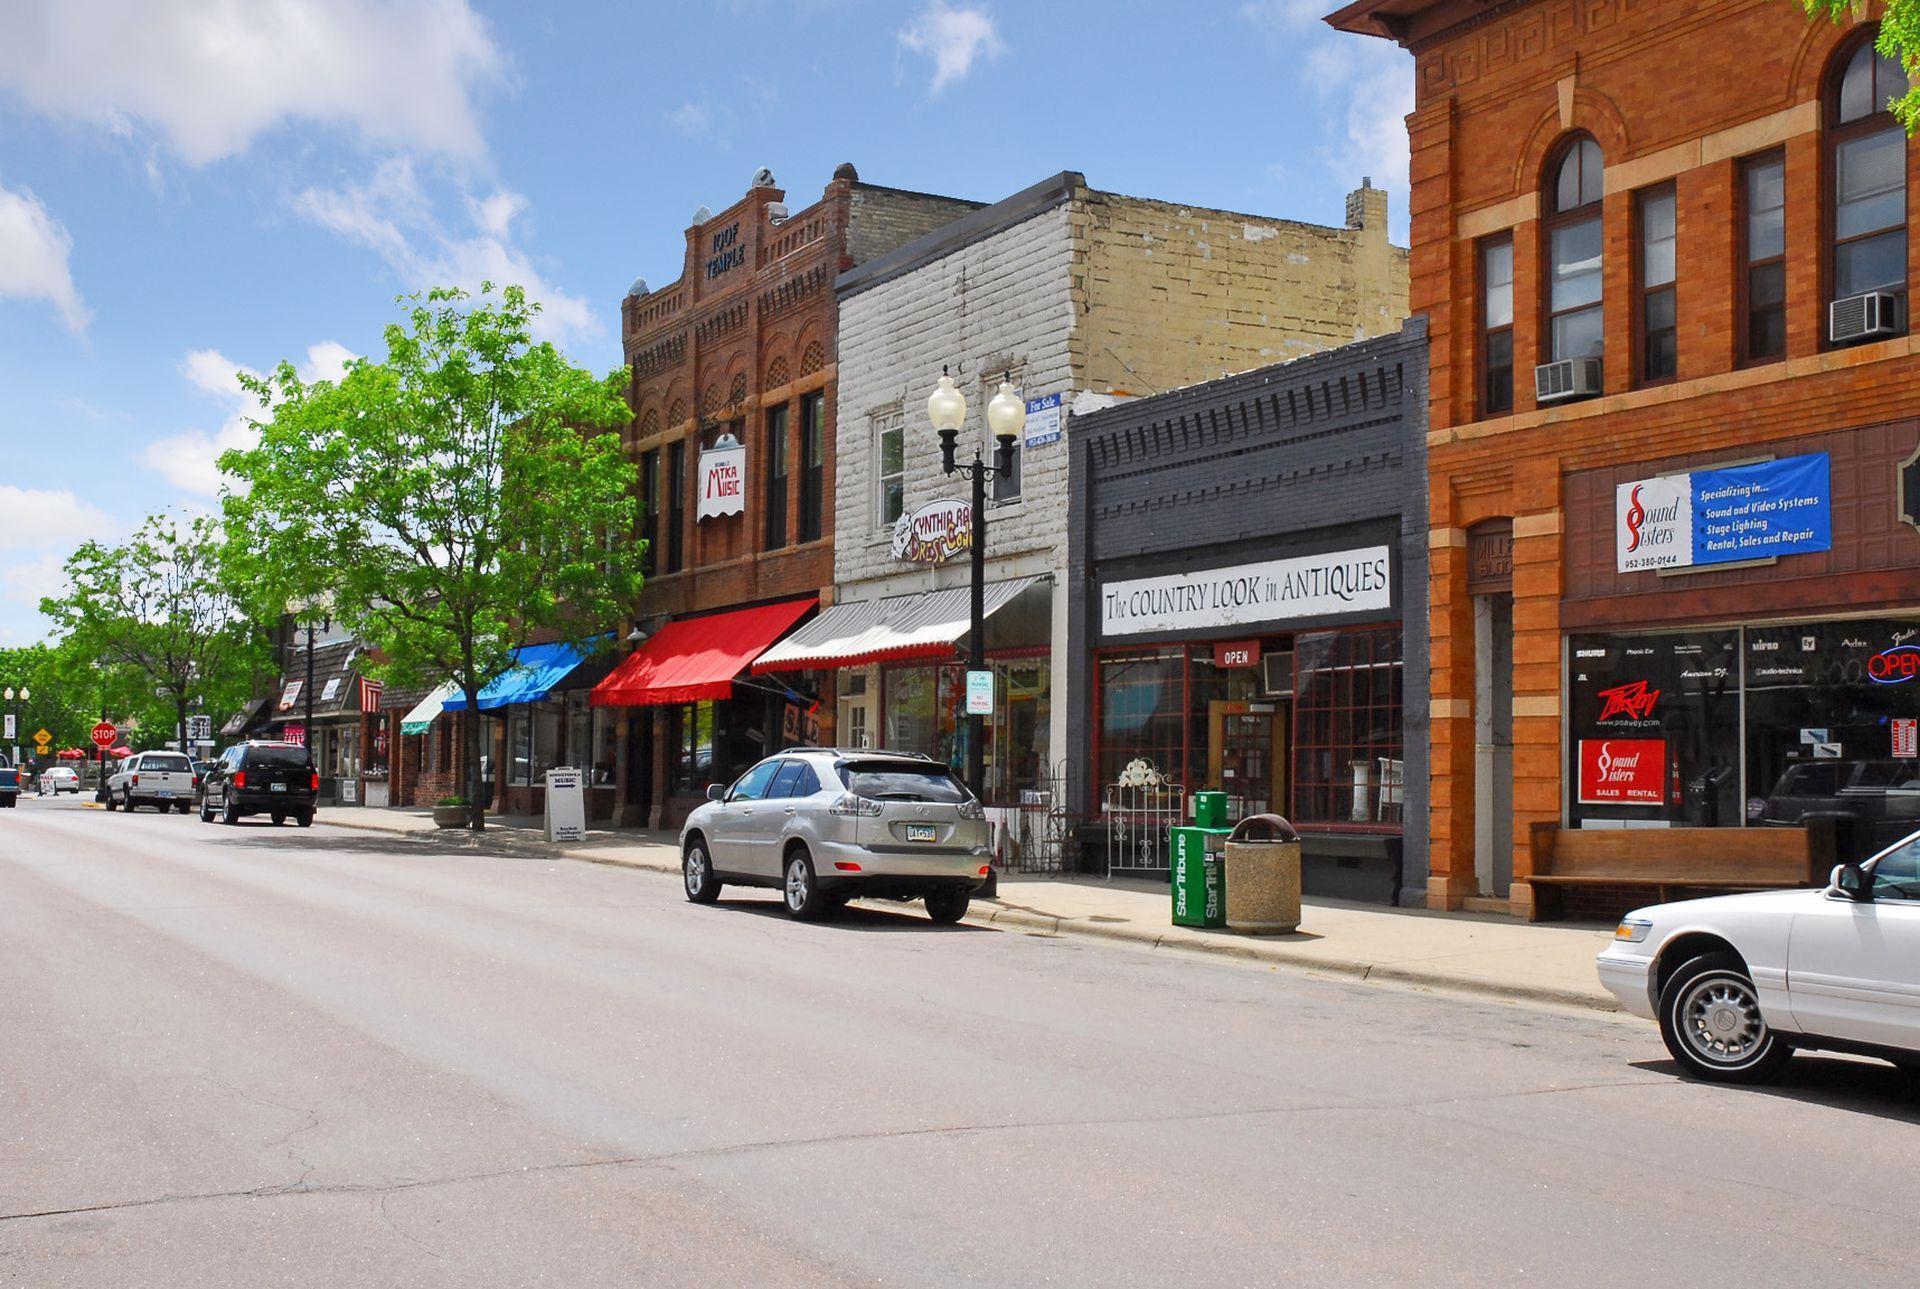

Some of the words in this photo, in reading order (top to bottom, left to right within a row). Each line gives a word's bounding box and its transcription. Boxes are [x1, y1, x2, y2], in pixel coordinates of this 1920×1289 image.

[706, 242, 745, 280] TEMPLE
[1030, 401, 1041, 412] For
[1042, 397, 1055, 410] Sale
[1700, 486, 1750, 502] Specializing
[1751, 482, 1769, 494] in...
[1706, 505, 1732, 519] Sound
[1733, 503, 1749, 516] and
[1751, 501, 1776, 513] Video
[1778, 496, 1819, 511] Systems
[1706, 523, 1731, 536] Stage
[1732, 518, 1768, 532] Lighting
[1707, 539, 1738, 551] Rental,
[1739, 535, 1762, 547] Sales
[1763, 533, 1780, 544] and
[1782, 530, 1814, 544] Repair
[1625, 555, 1677, 569] 952-380-0144
[1107, 590, 1126, 619] The
[1130, 583, 1208, 617] COUNTRY
[1212, 576, 1260, 609] LOOK
[1266, 577, 1277, 602] in
[1281, 559, 1386, 601] ANTIQUES
[1225, 651, 1248, 664] OPEN
[93, 729, 115, 740] STOP
[1596, 789, 1620, 797] SALES
[1627, 789, 1658, 798] RENTAL
